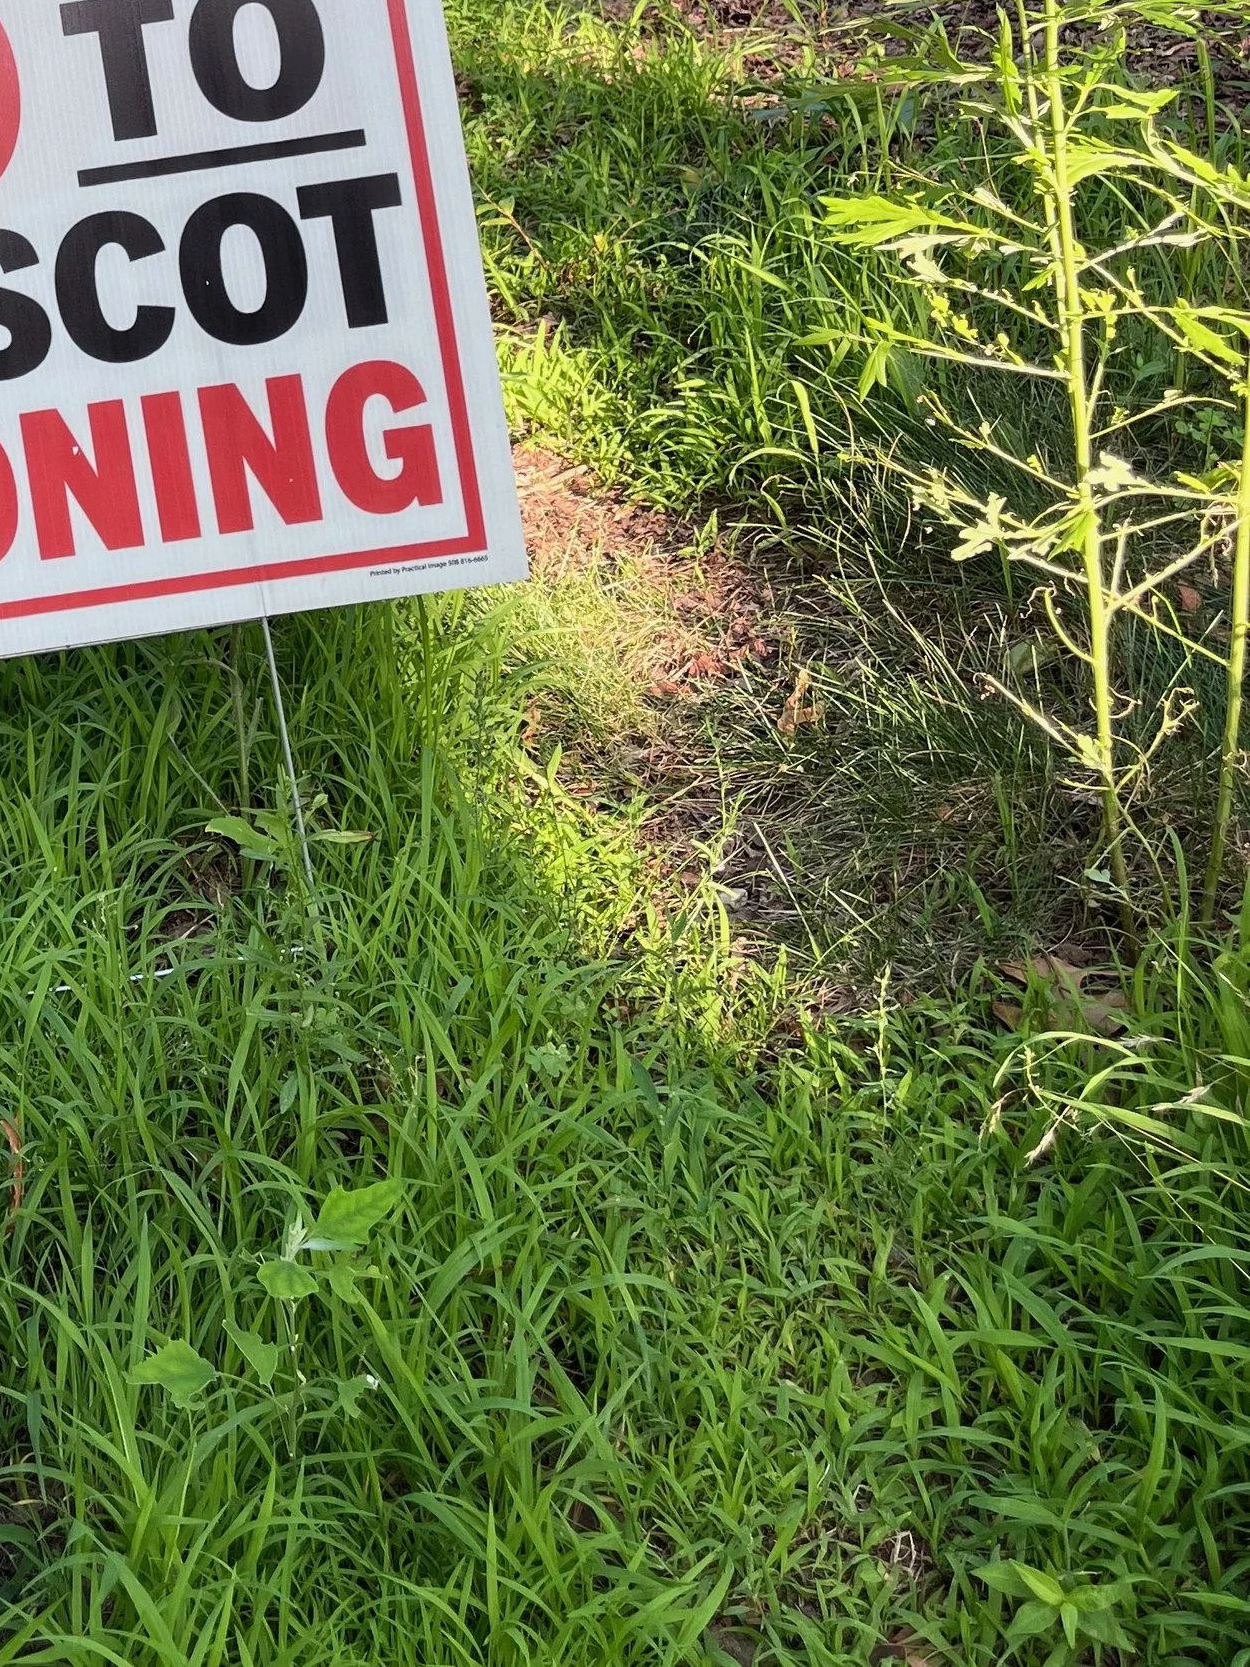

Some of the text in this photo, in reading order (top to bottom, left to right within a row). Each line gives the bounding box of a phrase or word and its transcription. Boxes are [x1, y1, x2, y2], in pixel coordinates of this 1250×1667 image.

[370, 568, 391, 576] Printed
[402, 563, 426, 572] Practical
[428, 562, 447, 570] Image
